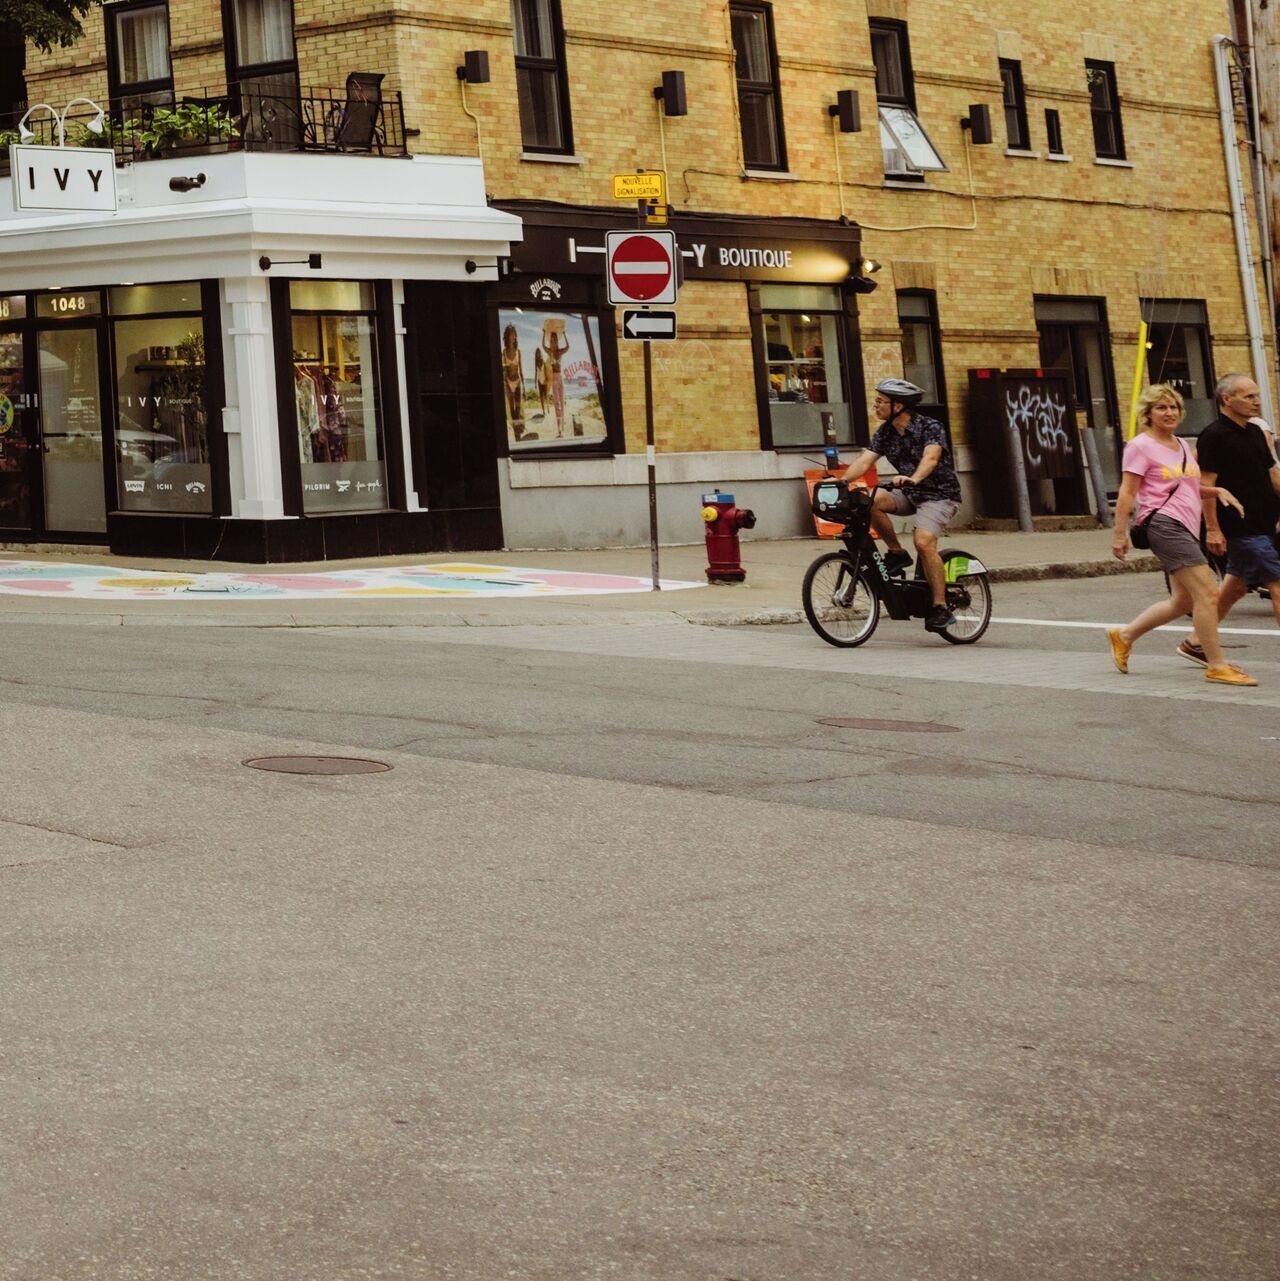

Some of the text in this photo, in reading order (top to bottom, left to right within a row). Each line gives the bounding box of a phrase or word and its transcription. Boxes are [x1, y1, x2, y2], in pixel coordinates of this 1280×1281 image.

[29, 167, 102, 192] IVY
[616, 188, 659, 196] SIGNALISATION
[720, 247, 792, 268] BOUTIQUE
[51, 297, 85, 312] 1048
[127, 396, 162, 408] IVY
[311, 394, 340, 405] IVY
[304, 483, 331, 491] PILGRIM
